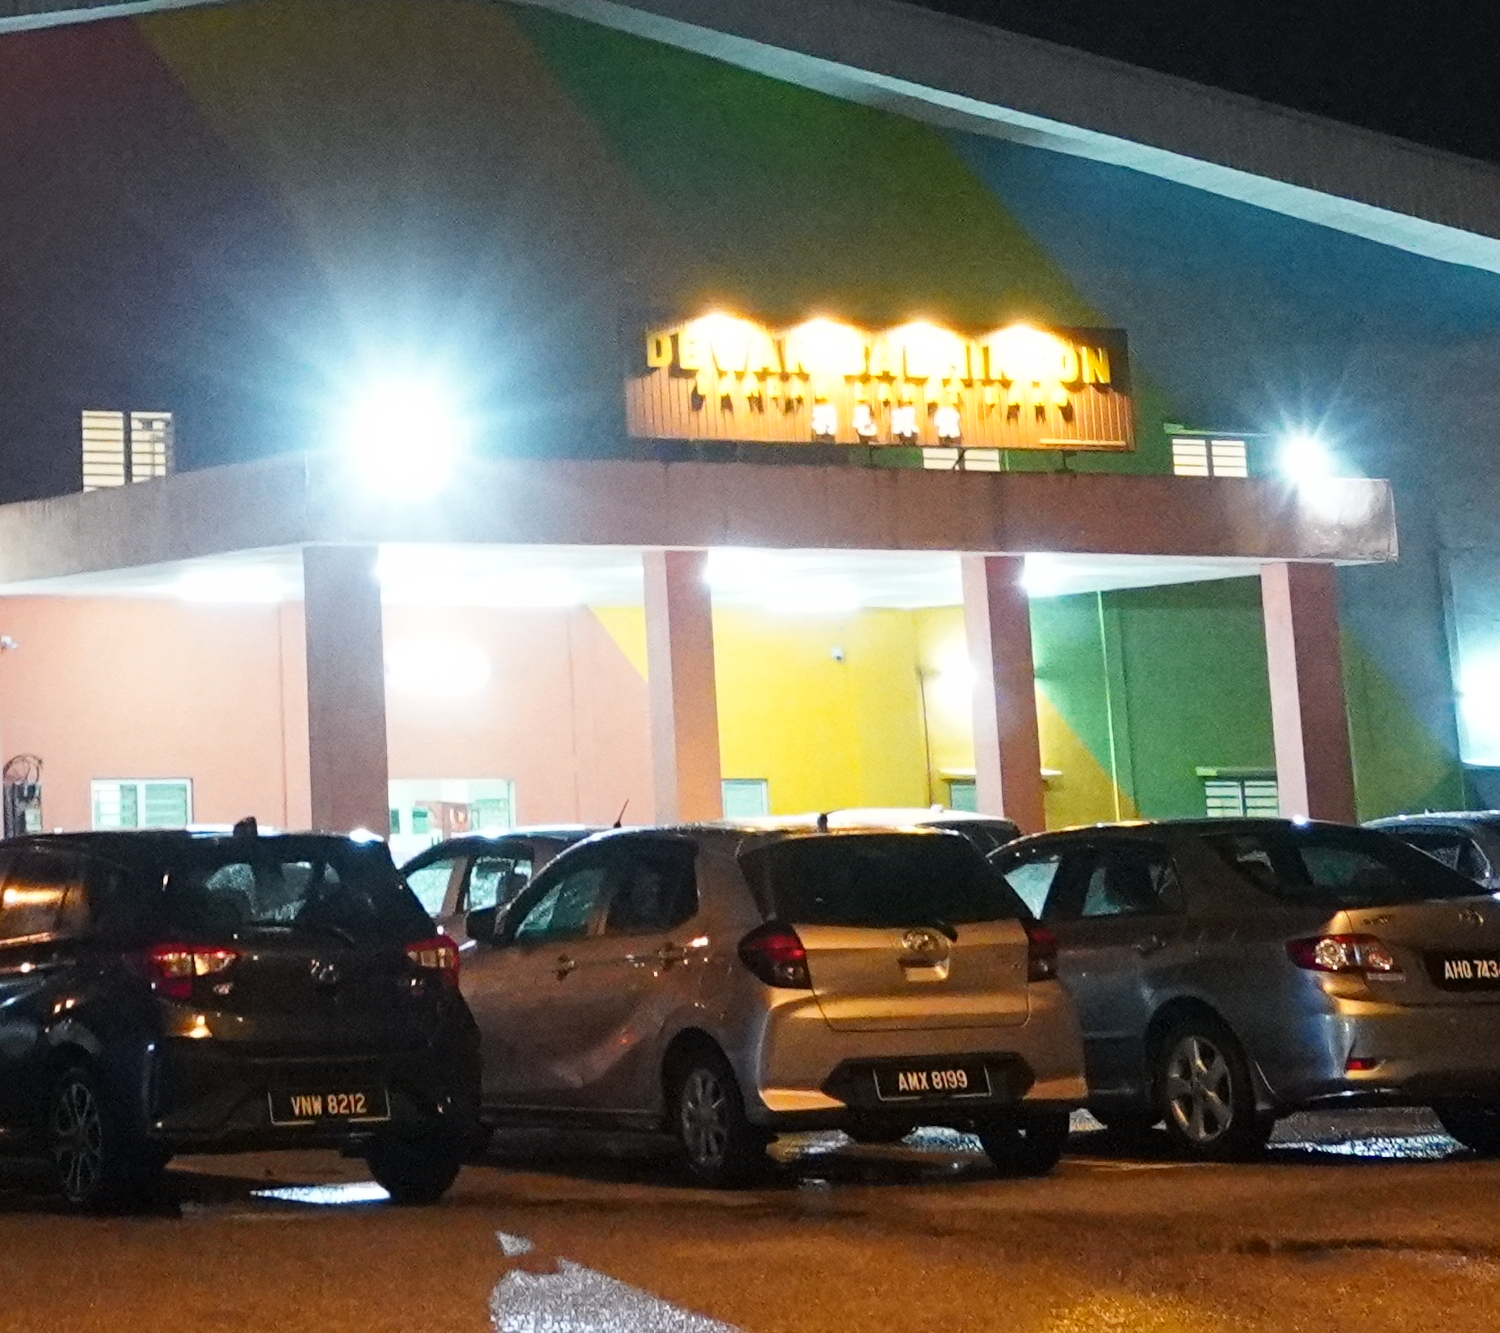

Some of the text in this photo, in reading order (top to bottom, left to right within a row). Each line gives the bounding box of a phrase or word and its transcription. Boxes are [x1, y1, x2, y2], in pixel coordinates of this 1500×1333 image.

[899, 1070, 967, 1091] AMX 8199
[291, 1093, 367, 1116] VNW 8212
